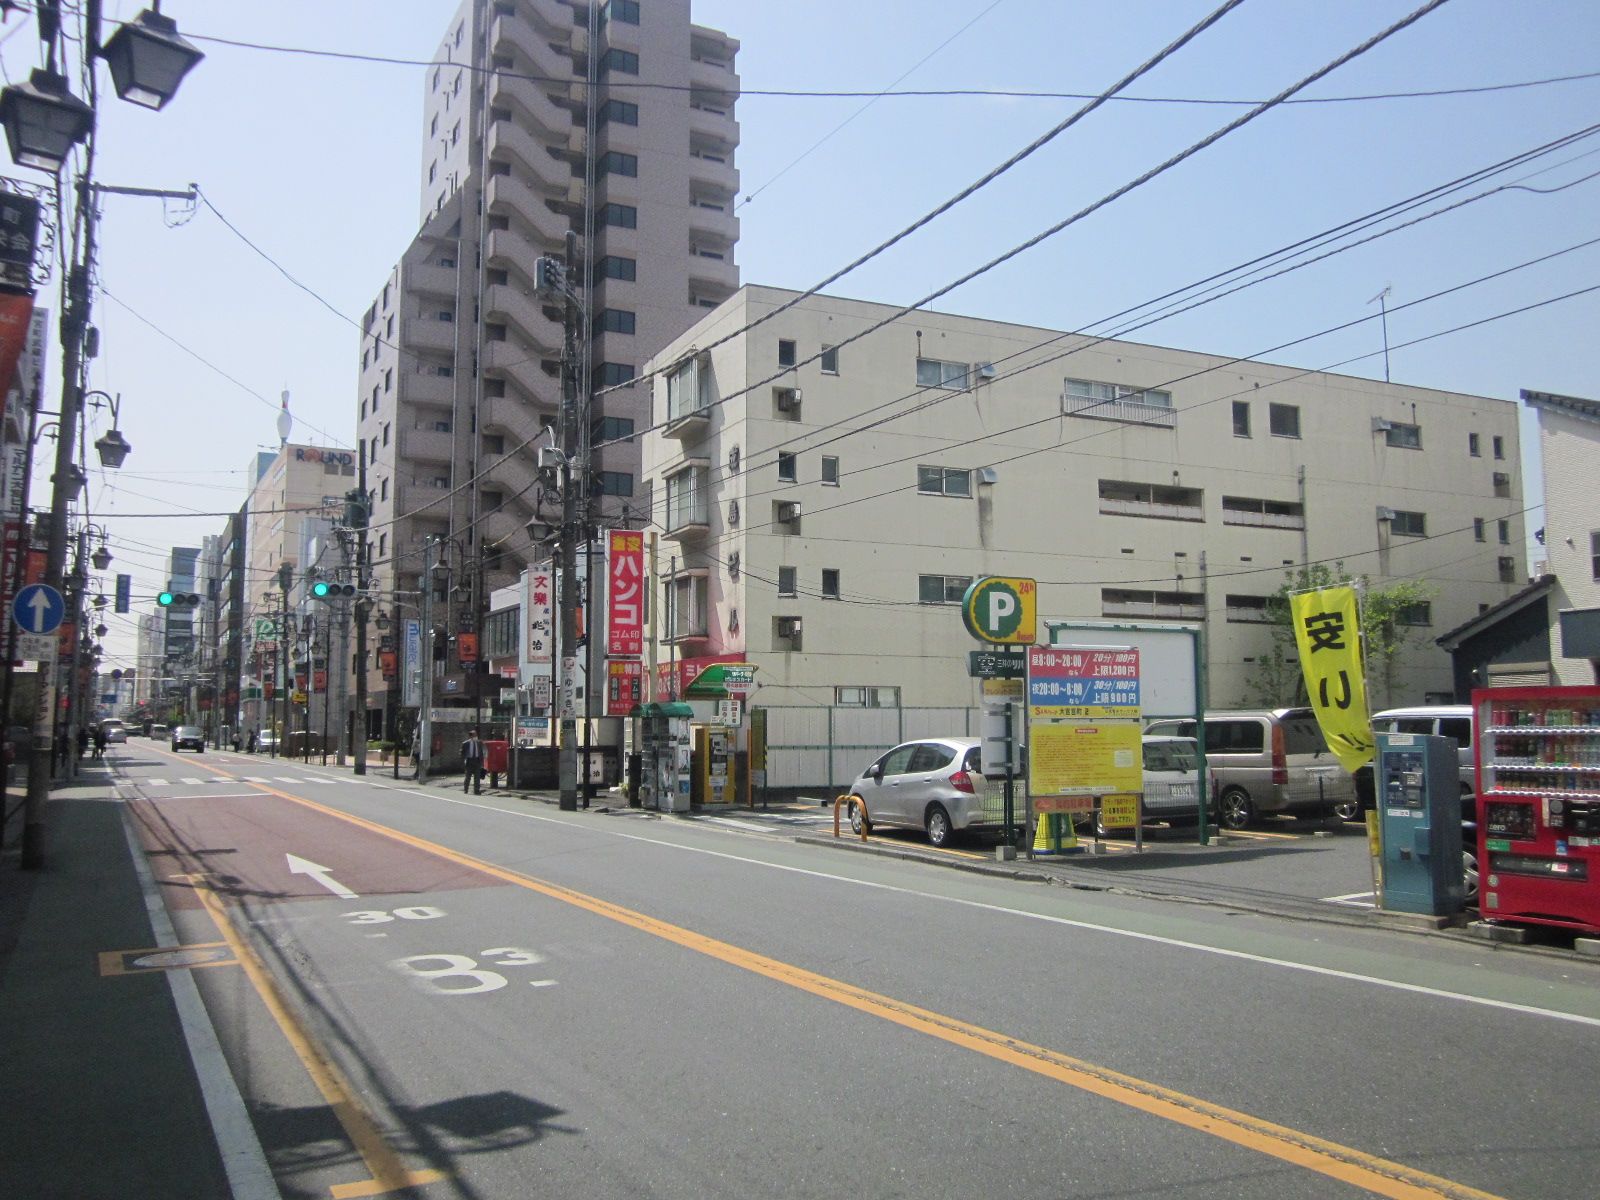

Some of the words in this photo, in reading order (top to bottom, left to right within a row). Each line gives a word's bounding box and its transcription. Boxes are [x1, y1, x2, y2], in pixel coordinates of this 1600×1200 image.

[296, 448, 353, 465] ROUND
[614, 555, 639, 625] ハンコ
[989, 591, 1015, 631] P
